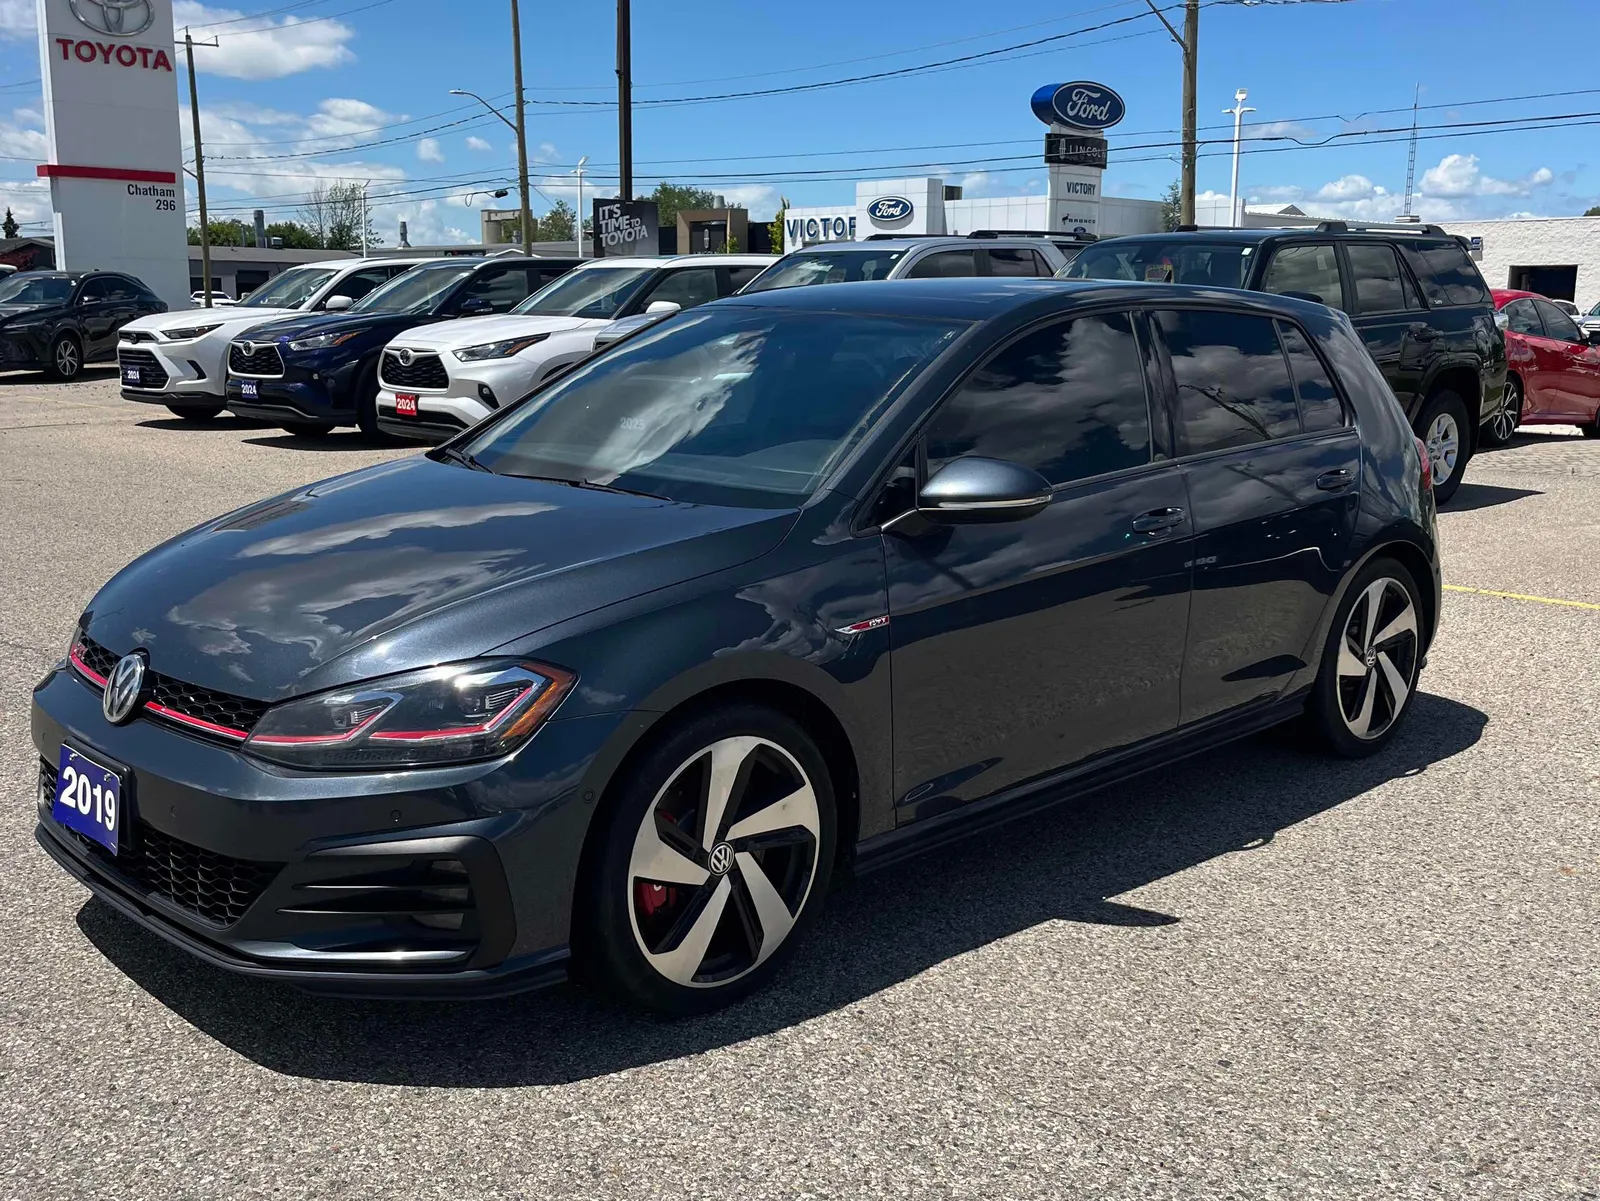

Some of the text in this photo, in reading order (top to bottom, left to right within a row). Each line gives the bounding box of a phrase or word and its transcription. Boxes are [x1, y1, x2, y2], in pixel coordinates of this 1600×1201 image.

[56, 38, 173, 72] TOYOTA
[1066, 88, 1111, 121] Ford
[127, 183, 176, 198] Chatham
[1066, 181, 1096, 196] VICTORY
[155, 199, 176, 211] 296
[599, 203, 621, 220] IT'S
[876, 200, 902, 216] Ford
[600, 215, 641, 234] TIME TO
[600, 225, 649, 247] TOYOTA
[127, 370, 140, 380] 2024
[241, 384, 257, 395] 2024
[396, 398, 416, 411] 2024
[620, 416, 645, 431] 2025
[60, 765, 116, 831] 2019
